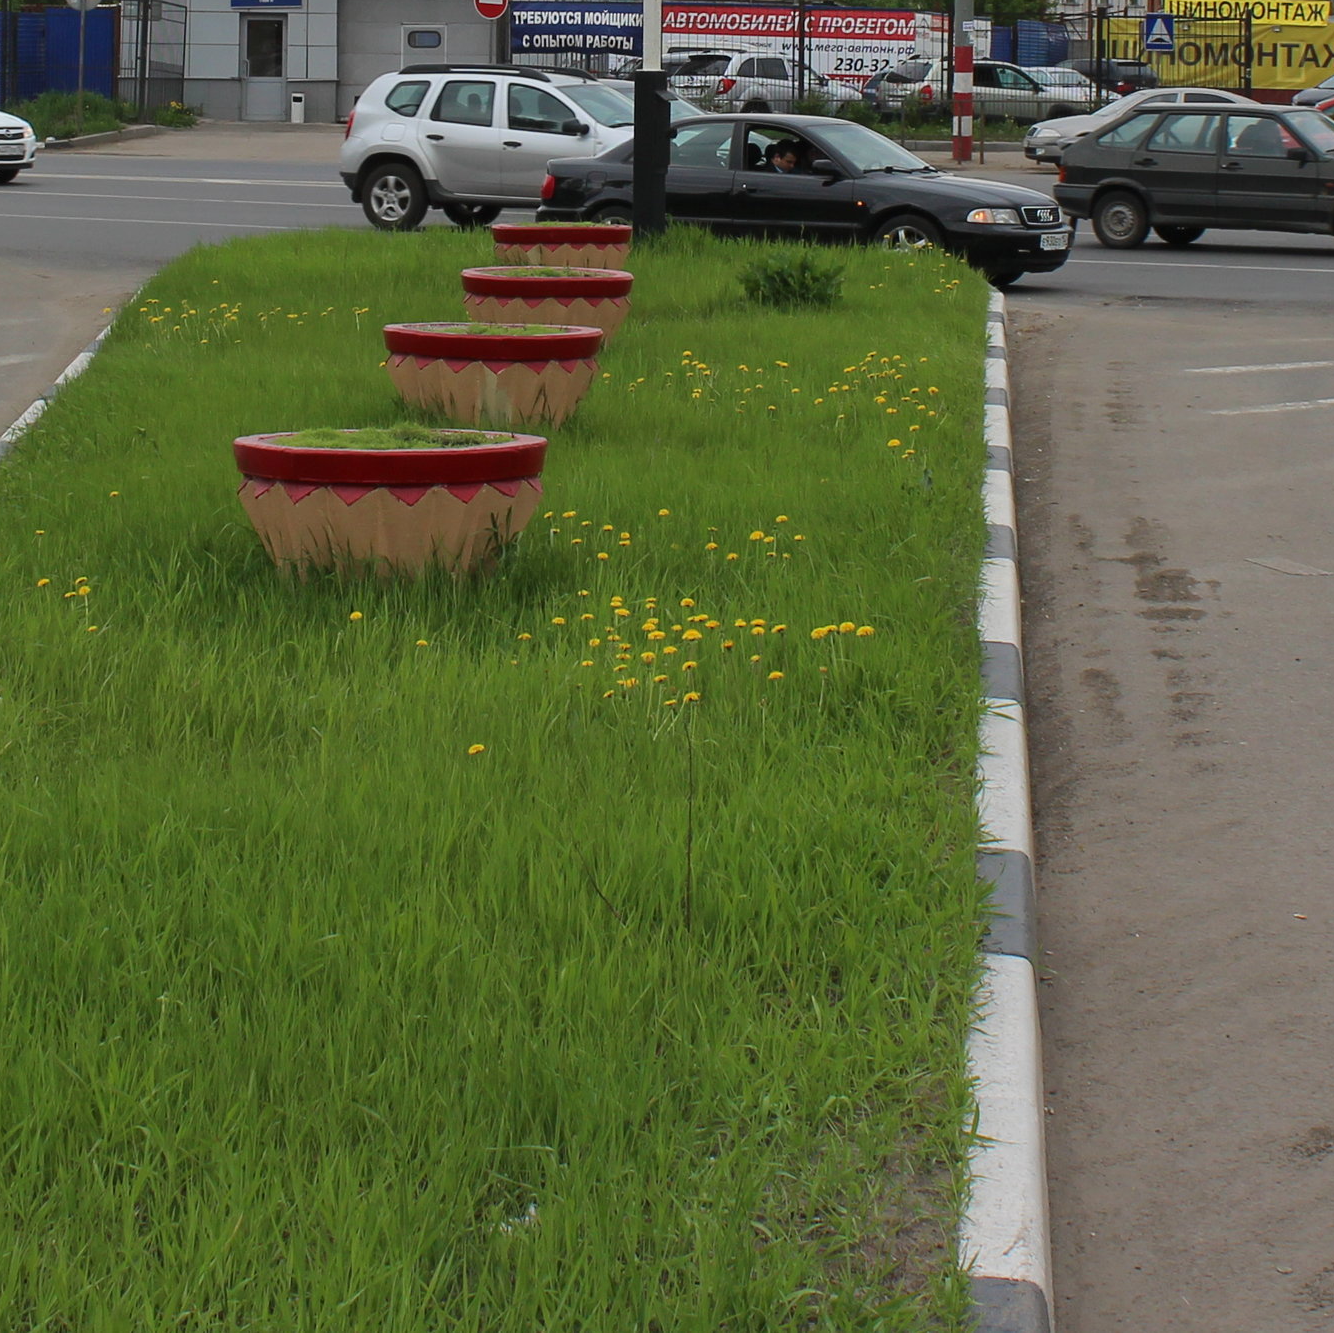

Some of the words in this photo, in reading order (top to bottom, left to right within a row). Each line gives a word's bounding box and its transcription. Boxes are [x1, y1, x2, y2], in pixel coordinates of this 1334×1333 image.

[513, 10, 582, 25] ТРЕБУЮТСЯ
[584, 10, 643, 28] МОЙЩИКИ
[1169, 0, 1326, 21] ШИНОМОНТАЖ
[663, 11, 800, 32] АВТОМОБИЛЕЙ
[817, 15, 916, 36] ПРОБЕГОМ
[522, 35, 530, 47] С
[533, 34, 583, 48] ОПЫТОМ
[586, 35, 633, 50] РАБОТЫ
